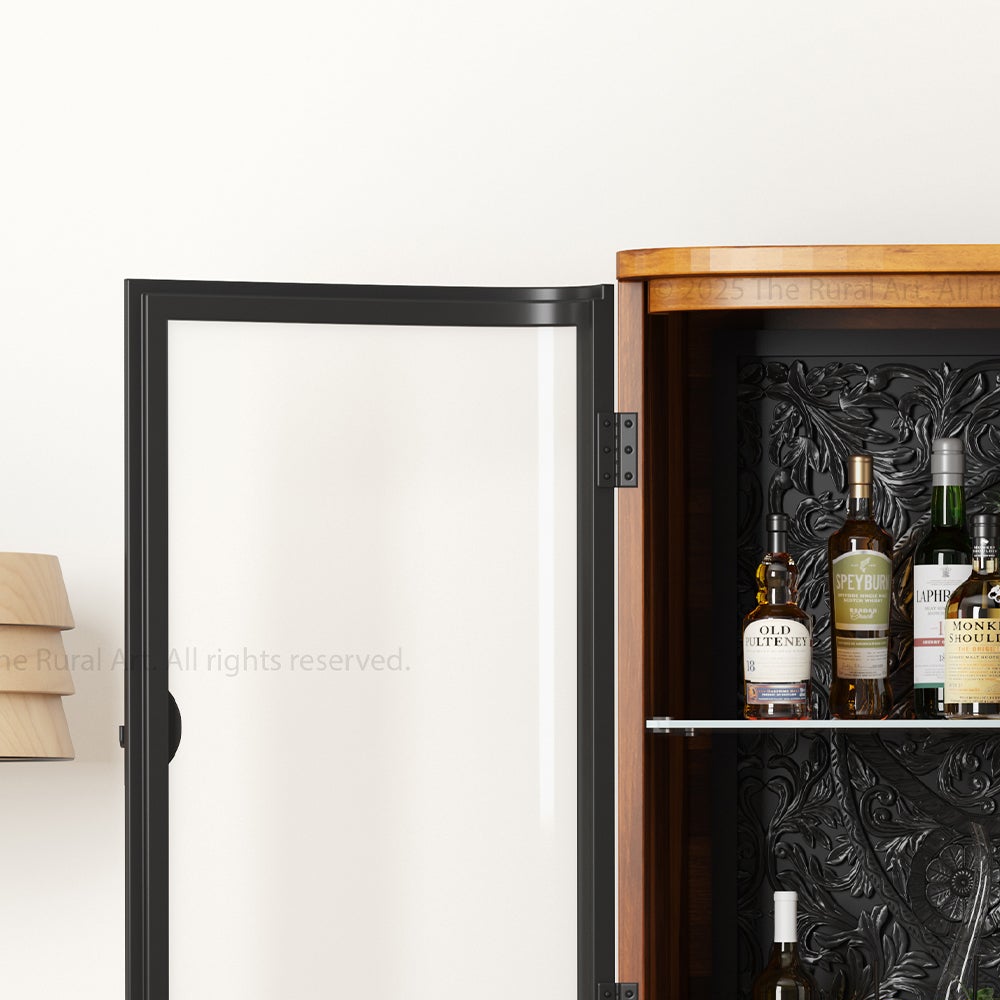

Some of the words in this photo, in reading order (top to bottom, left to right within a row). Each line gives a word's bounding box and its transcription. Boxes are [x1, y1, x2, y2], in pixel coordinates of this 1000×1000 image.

[916, 590, 951, 603] LAPHR
[760, 625, 791, 635] OLD
[745, 636, 808, 647] PULTENEY
[747, 660, 756, 672] 18
